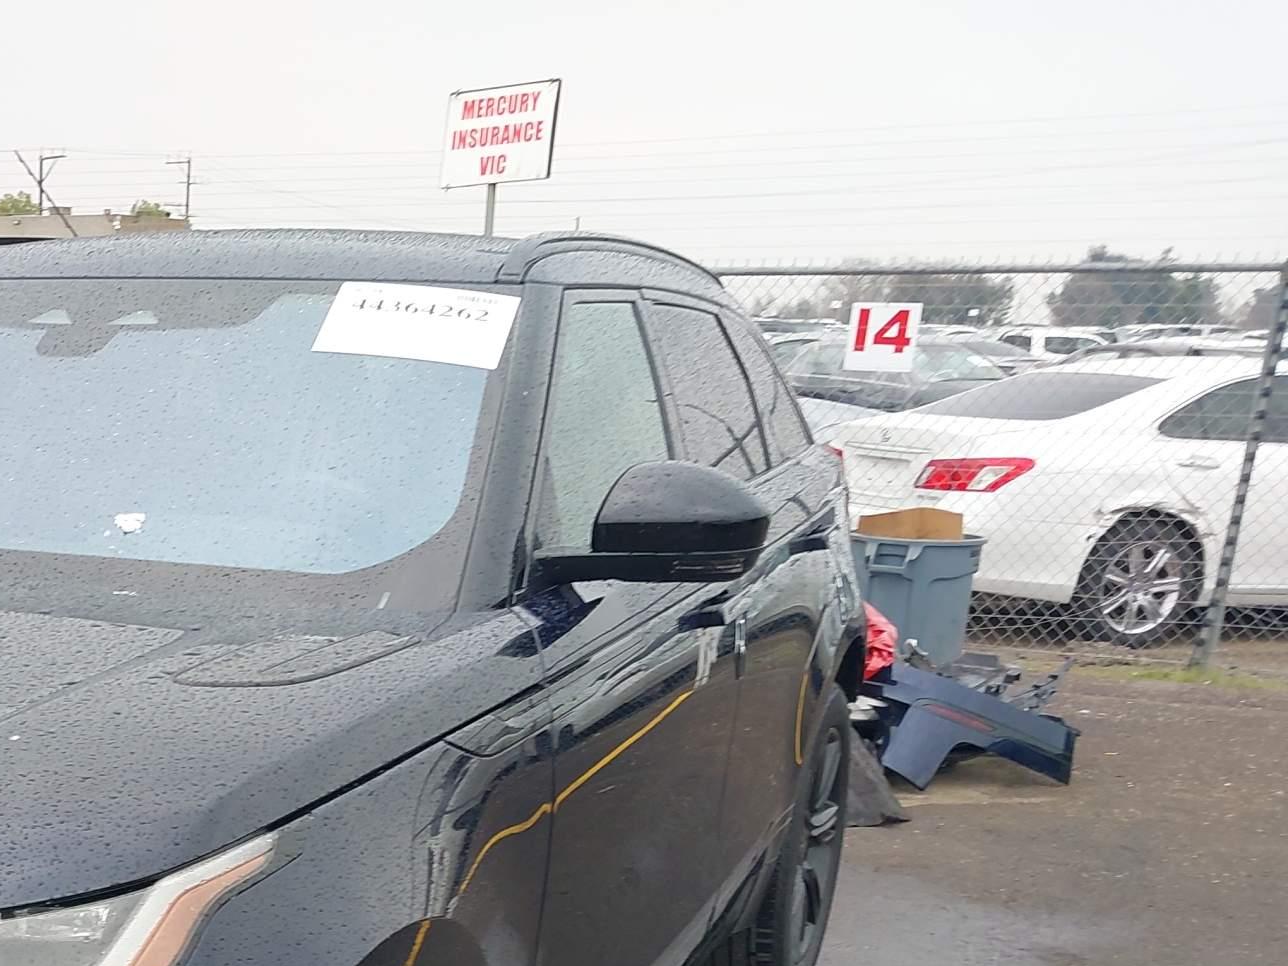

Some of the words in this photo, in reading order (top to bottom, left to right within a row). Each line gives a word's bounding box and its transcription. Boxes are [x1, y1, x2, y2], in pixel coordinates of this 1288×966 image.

[461, 91, 541, 120] MERCURY
[451, 120, 544, 150] INSURANCE
[480, 154, 506, 176] VIC
[352, 298, 489, 322] 44364262
[854, 308, 911, 353] 14
